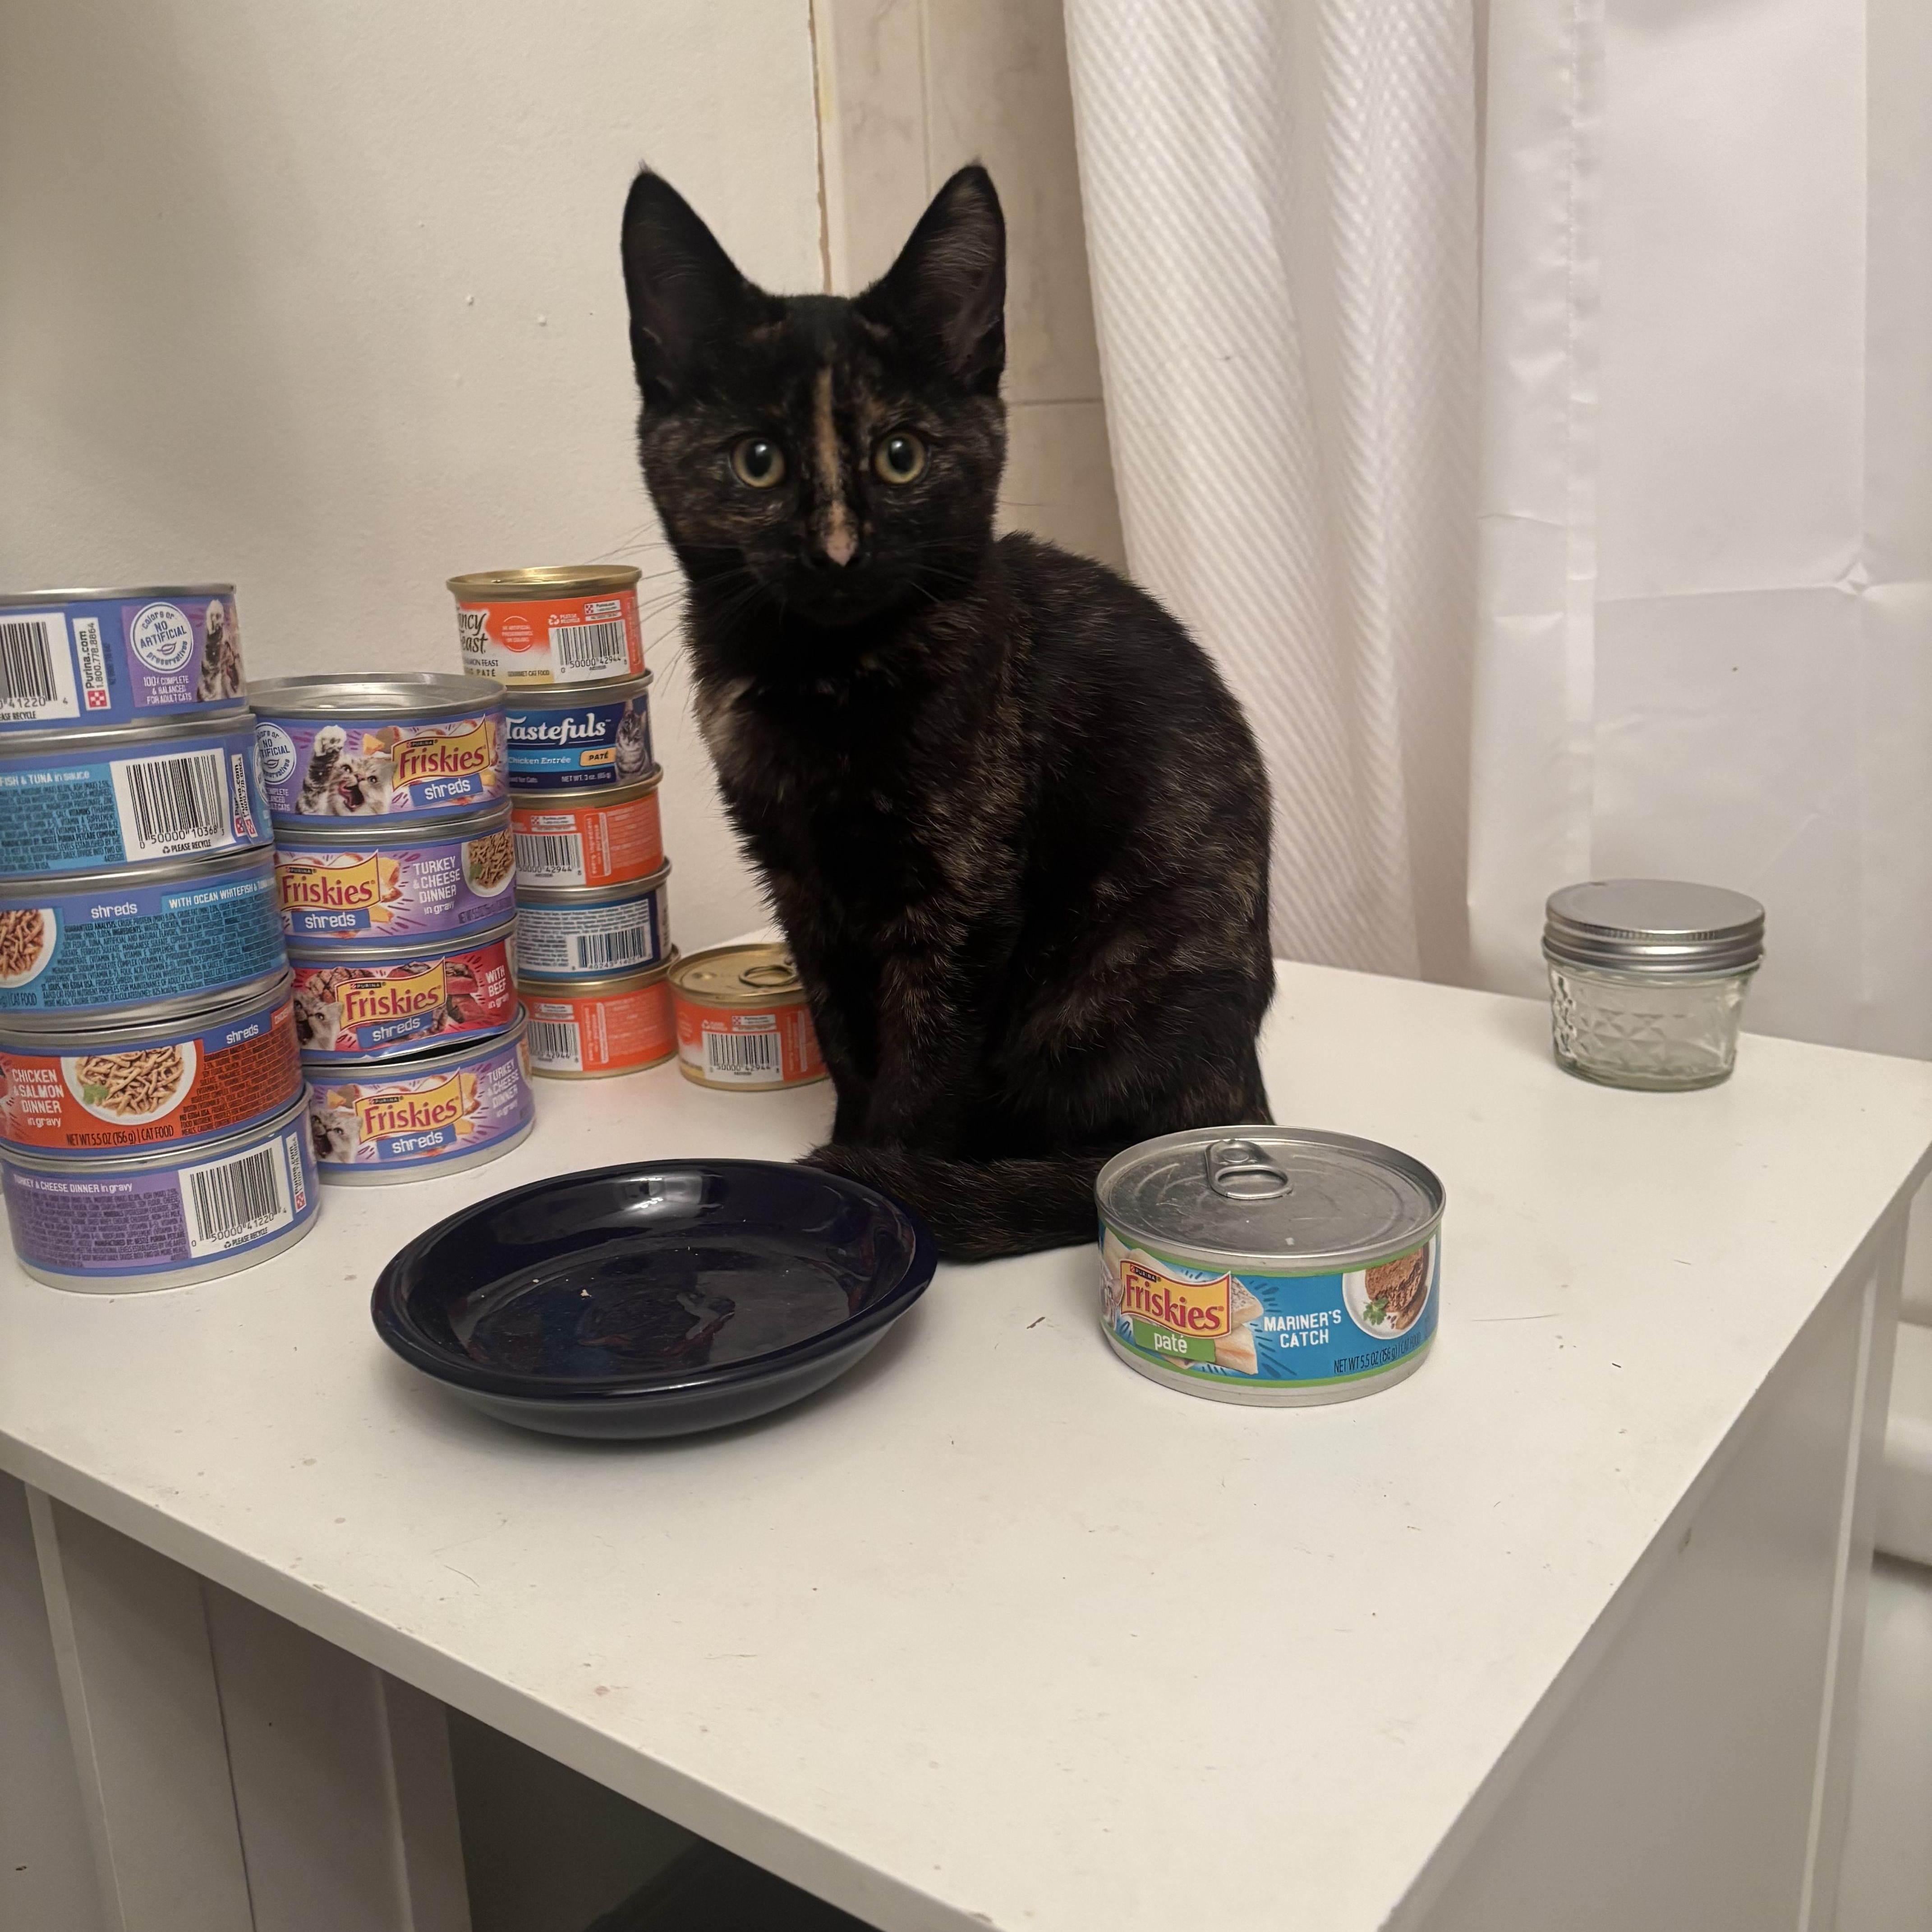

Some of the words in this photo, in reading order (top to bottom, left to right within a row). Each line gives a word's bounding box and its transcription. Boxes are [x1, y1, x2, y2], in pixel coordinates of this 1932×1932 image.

[142, 611, 164, 629] colors
[154, 621, 168, 633] NO
[140, 626, 187, 649] ARTIFICIAL
[80, 631, 94, 689] Purina.com
[146, 641, 188, 666] preservatives
[570, 659, 595, 668] 50000
[158, 685, 186, 694] BALANCED
[161, 675, 189, 685] COMPLETE
[179, 693, 192, 702] CATS
[12, 711, 37, 720] RECYCLE
[506, 713, 606, 745] Tastefuls
[260, 745, 290, 759] TIFICIAL
[262, 739, 273, 748] NO
[400, 745, 486, 780] Friskies
[589, 750, 609, 760] PATÉ
[28, 773, 52, 784] TUNA
[424, 778, 471, 800] shreds
[151, 831, 185, 845] 50000
[191, 825, 217, 838] 10368
[171, 841, 191, 853] PLEASE
[192, 838, 212, 850] RECYCLE
[413, 856, 456, 875] TURKEY
[420, 869, 461, 889] CHEESE
[169, 897, 192, 909] WITH
[193, 892, 218, 905] OCEAN
[220, 884, 253, 900] WHITEFISH
[282, 875, 373, 906] Friskies
[419, 884, 457, 903] DINNER
[91, 902, 138, 919] shreds
[424, 905, 432, 915] in
[305, 912, 356, 929] shreds
[485, 965, 505, 984] WITH
[488, 978, 506, 998] BEEF
[346, 987, 439, 1021] Friskies
[226, 1024, 259, 1045] shreds
[372, 1017, 421, 1042] shreds
[12, 1069, 57, 1082] CHICKEN
[487, 1058, 515, 1083] TURKEY
[492, 1069, 520, 1094] CHEESE
[19, 1085, 64, 1099] SALMON
[492, 1084, 518, 1109] DINNER
[22, 1100, 62, 1113] DINNER
[36, 1117, 61, 1128] gravy
[364, 1099, 457, 1135] Friskies
[66, 1133, 79, 1146] NET
[79, 1133, 90, 1145] WT
[91, 1133, 102, 1145] 5.5
[102, 1132, 111, 1145] OZ
[141, 1127, 154, 1141] CAT
[154, 1125, 174, 1140] FOOD
[392, 1132, 443, 1154] shreds
[41, 1181, 68, 1192] CHEESE
[70, 1183, 100, 1193] DINNER
[101, 1183, 108, 1192] in
[109, 1182, 132, 1194] gravy
[211, 1225, 243, 1242] 50000
[248, 1213, 274, 1230] 41220
[232, 1234, 249, 1246] PLEASE
[1135, 1268, 1156, 1281] PURINA
[1126, 1274, 1220, 1330] Friskies
[1264, 1309, 1342, 1332] MARINER'S
[1154, 1333, 1187, 1353] paté
[1280, 1329, 1329, 1348] CATCH
[1334, 1358, 1347, 1374] NET
[1348, 1356, 1360, 1371] WT
[1360, 1353, 1370, 1369] 5.5
[1371, 1351, 1379, 1365] OZ
